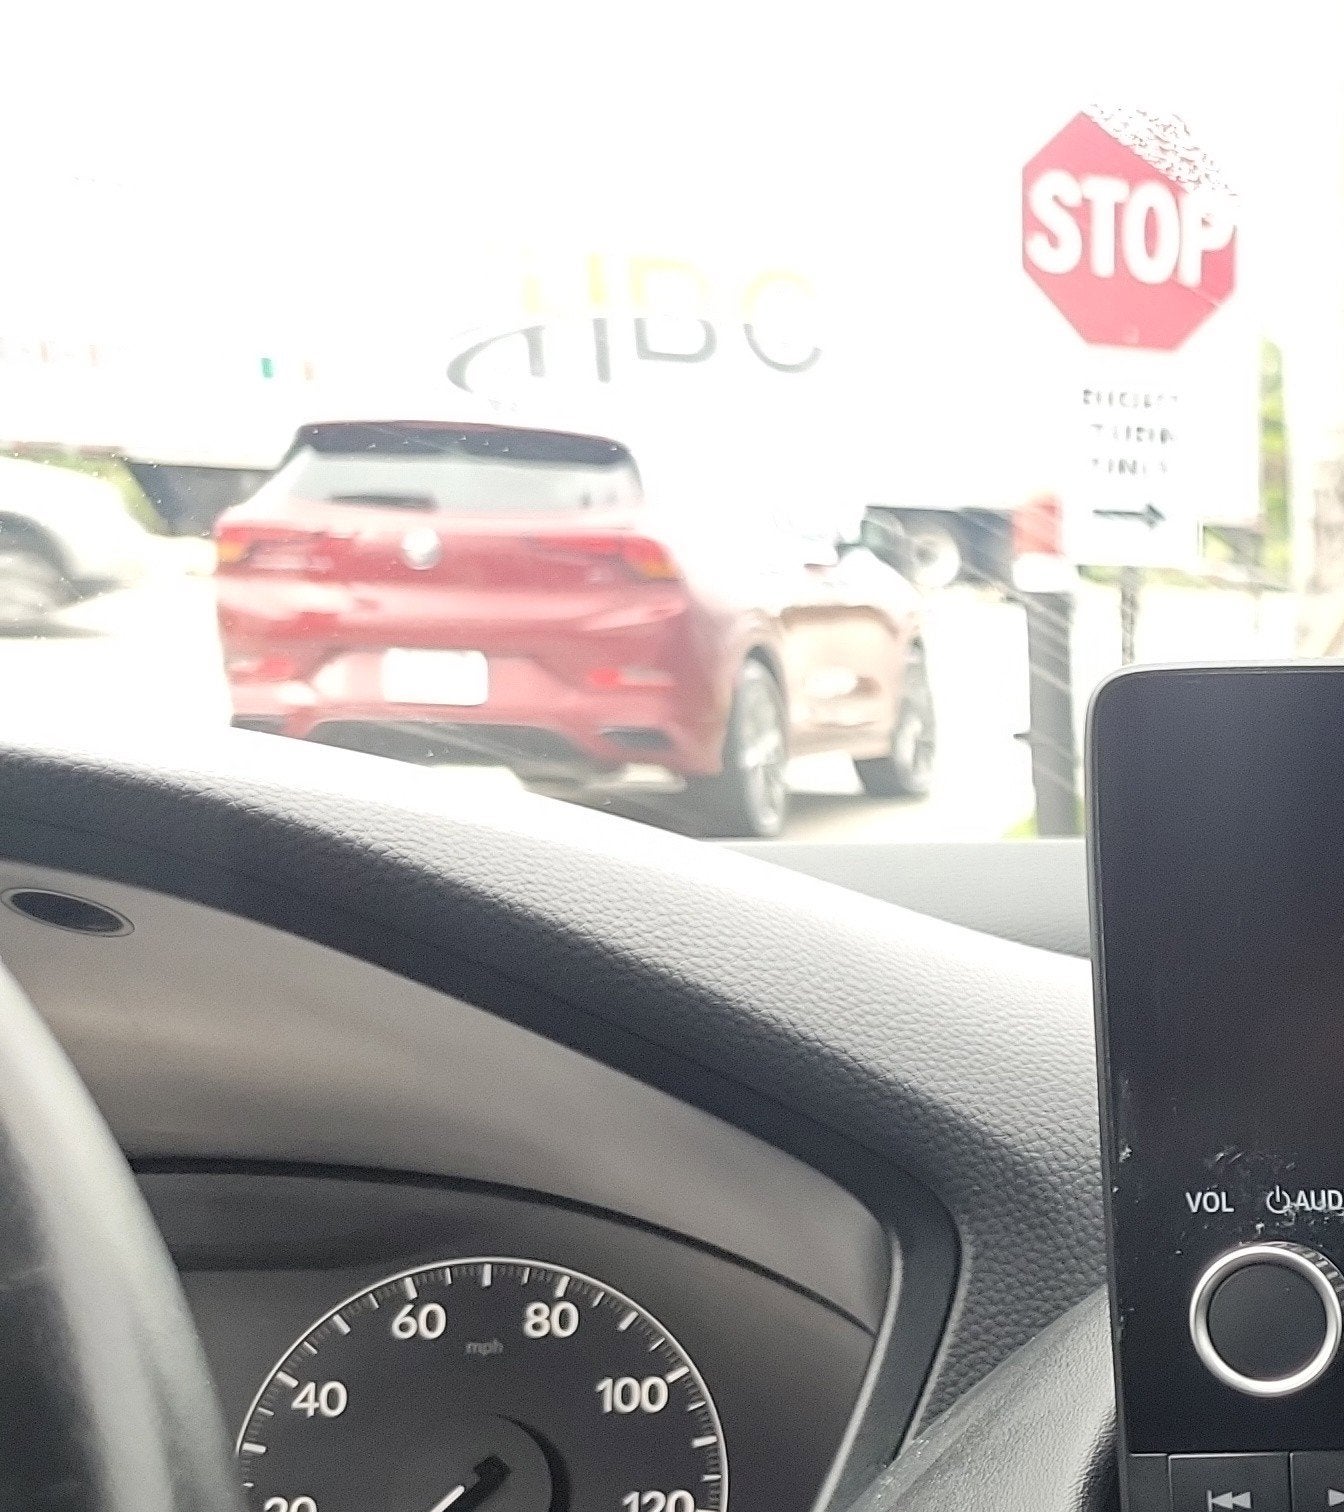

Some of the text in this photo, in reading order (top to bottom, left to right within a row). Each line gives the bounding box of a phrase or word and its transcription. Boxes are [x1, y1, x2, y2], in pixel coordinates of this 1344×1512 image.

[1027, 169, 1238, 288] STOP
[1185, 1191, 1235, 1213] VOL
[391, 1302, 448, 1339] 60
[522, 1301, 579, 1338] 80
[291, 1380, 348, 1417] 40
[595, 1376, 669, 1413] 100
